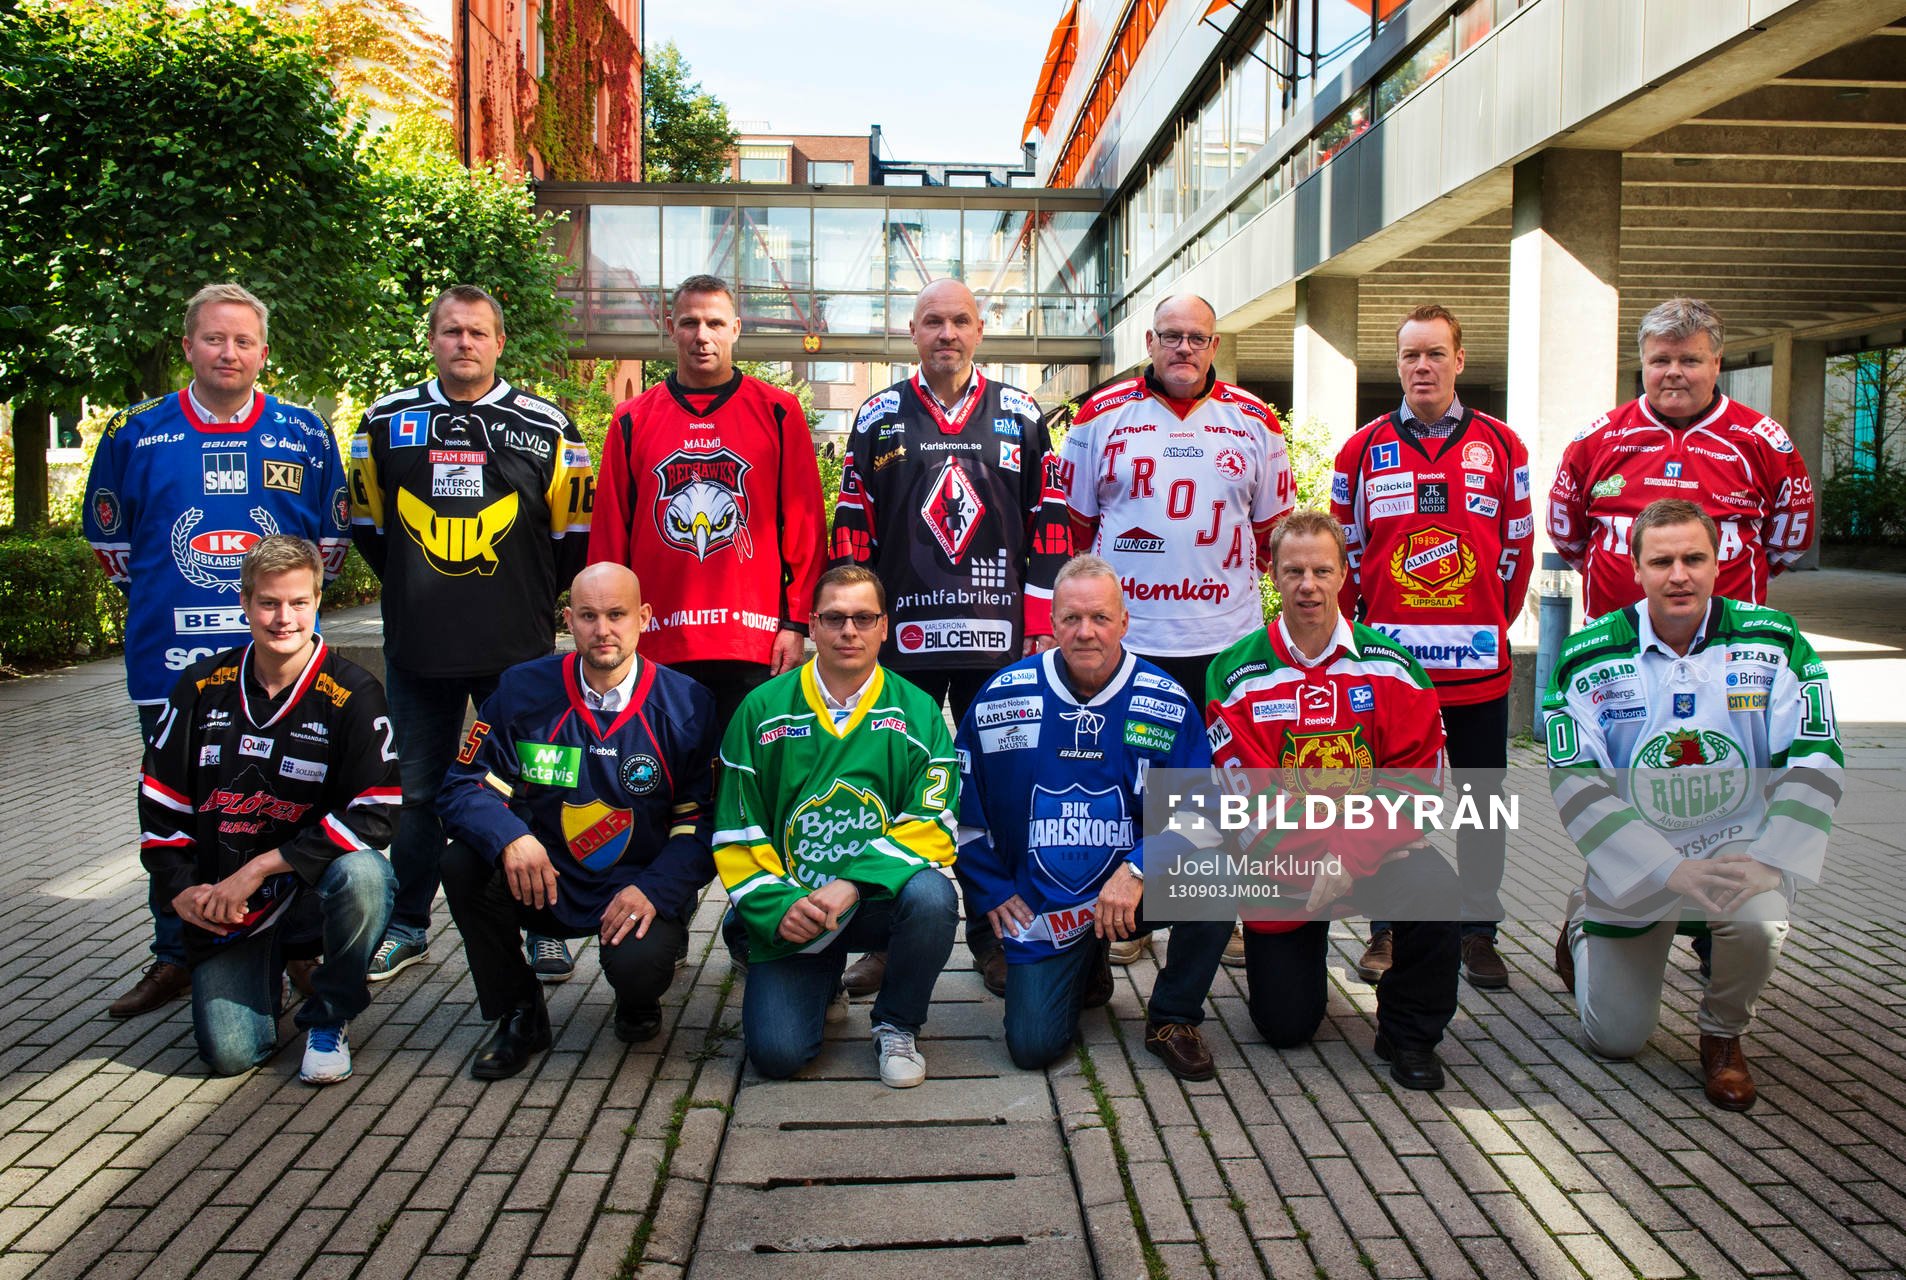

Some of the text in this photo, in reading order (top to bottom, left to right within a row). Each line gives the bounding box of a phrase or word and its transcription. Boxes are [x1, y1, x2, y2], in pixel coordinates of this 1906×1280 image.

[689, 422, 715, 430] Reebok
[444, 438, 471, 447] Reebok
[504, 429, 551, 453] INVID
[1169, 431, 1195, 439] Reebok
[683, 437, 721, 450] MALMÖ
[919, 441, 983, 451] Karlskrona.se
[431, 451, 457, 463] TEAM
[1163, 446, 1203, 458] Atteviks
[1695, 447, 1740, 462] INTERSPORT
[267, 464, 298, 489] XL
[666, 461, 737, 490] REDHAWKS
[1417, 472, 1446, 480] Reebok
[1665, 462, 1682, 478] ST
[205, 470, 247, 490] SKB
[433, 477, 481, 489] INTEROC
[955, 465, 984, 509] KARLSKRONA
[1375, 480, 1413, 493] Däckia
[433, 486, 481, 497] AKUSTIK
[569, 476, 595, 513] 16
[1419, 496, 1446, 505] JABER
[1480, 497, 1497, 508] INTER
[1419, 505, 1446, 513] MODE
[1479, 504, 1495, 515] SPORT
[1768, 511, 1809, 548] 15
[209, 534, 246, 551] IK
[1428, 536, 1440, 545] 32
[1406, 542, 1458, 571] ALMTUNA
[1438, 557, 1451, 575] S
[1120, 577, 1230, 605] Hemköp
[1413, 598, 1453, 607] UPPSALA
[924, 622, 967, 631] KARLSKRONA
[1741, 619, 1793, 633] BAUER
[924, 630, 1006, 650] BILCENTER
[1565, 634, 1609, 657] BAUER
[1363, 646, 1411, 667] FM Mattsson
[1730, 650, 1780, 665] PEAB
[1226, 662, 1268, 686] FM Mattsson
[1588, 663, 1636, 684] SOLID
[986, 698, 1031, 712] Alfred Nobels
[1592, 689, 1636, 705] Gullbergs
[1728, 695, 1751, 709] CITY
[977, 708, 1042, 725] KARLSKOGA
[373, 716, 399, 763] 2
[761, 725, 810, 744] INTERSORT
[997, 734, 1028, 745] INTEROC
[1125, 732, 1172, 751] VÄRMLAND
[589, 745, 618, 757] Rebok
[999, 741, 1029, 751] AKUSTIK
[1059, 749, 1104, 760] BAUER
[623, 756, 658, 771] EUROPEAN
[521, 762, 574, 783] Actavis
[1284, 757, 1296, 789] MORA
[625, 781, 654, 792] TROPHY
[1650, 768, 1737, 820] RÖGLE
[1060, 801, 1092, 818] BIK
[1657, 806, 1730, 829] ÄNGELHOLM
[797, 805, 882, 845] Björk
[1677, 823, 1744, 859] erstorp
[793, 838, 869, 864] löve
[1047, 903, 1098, 934] MA
